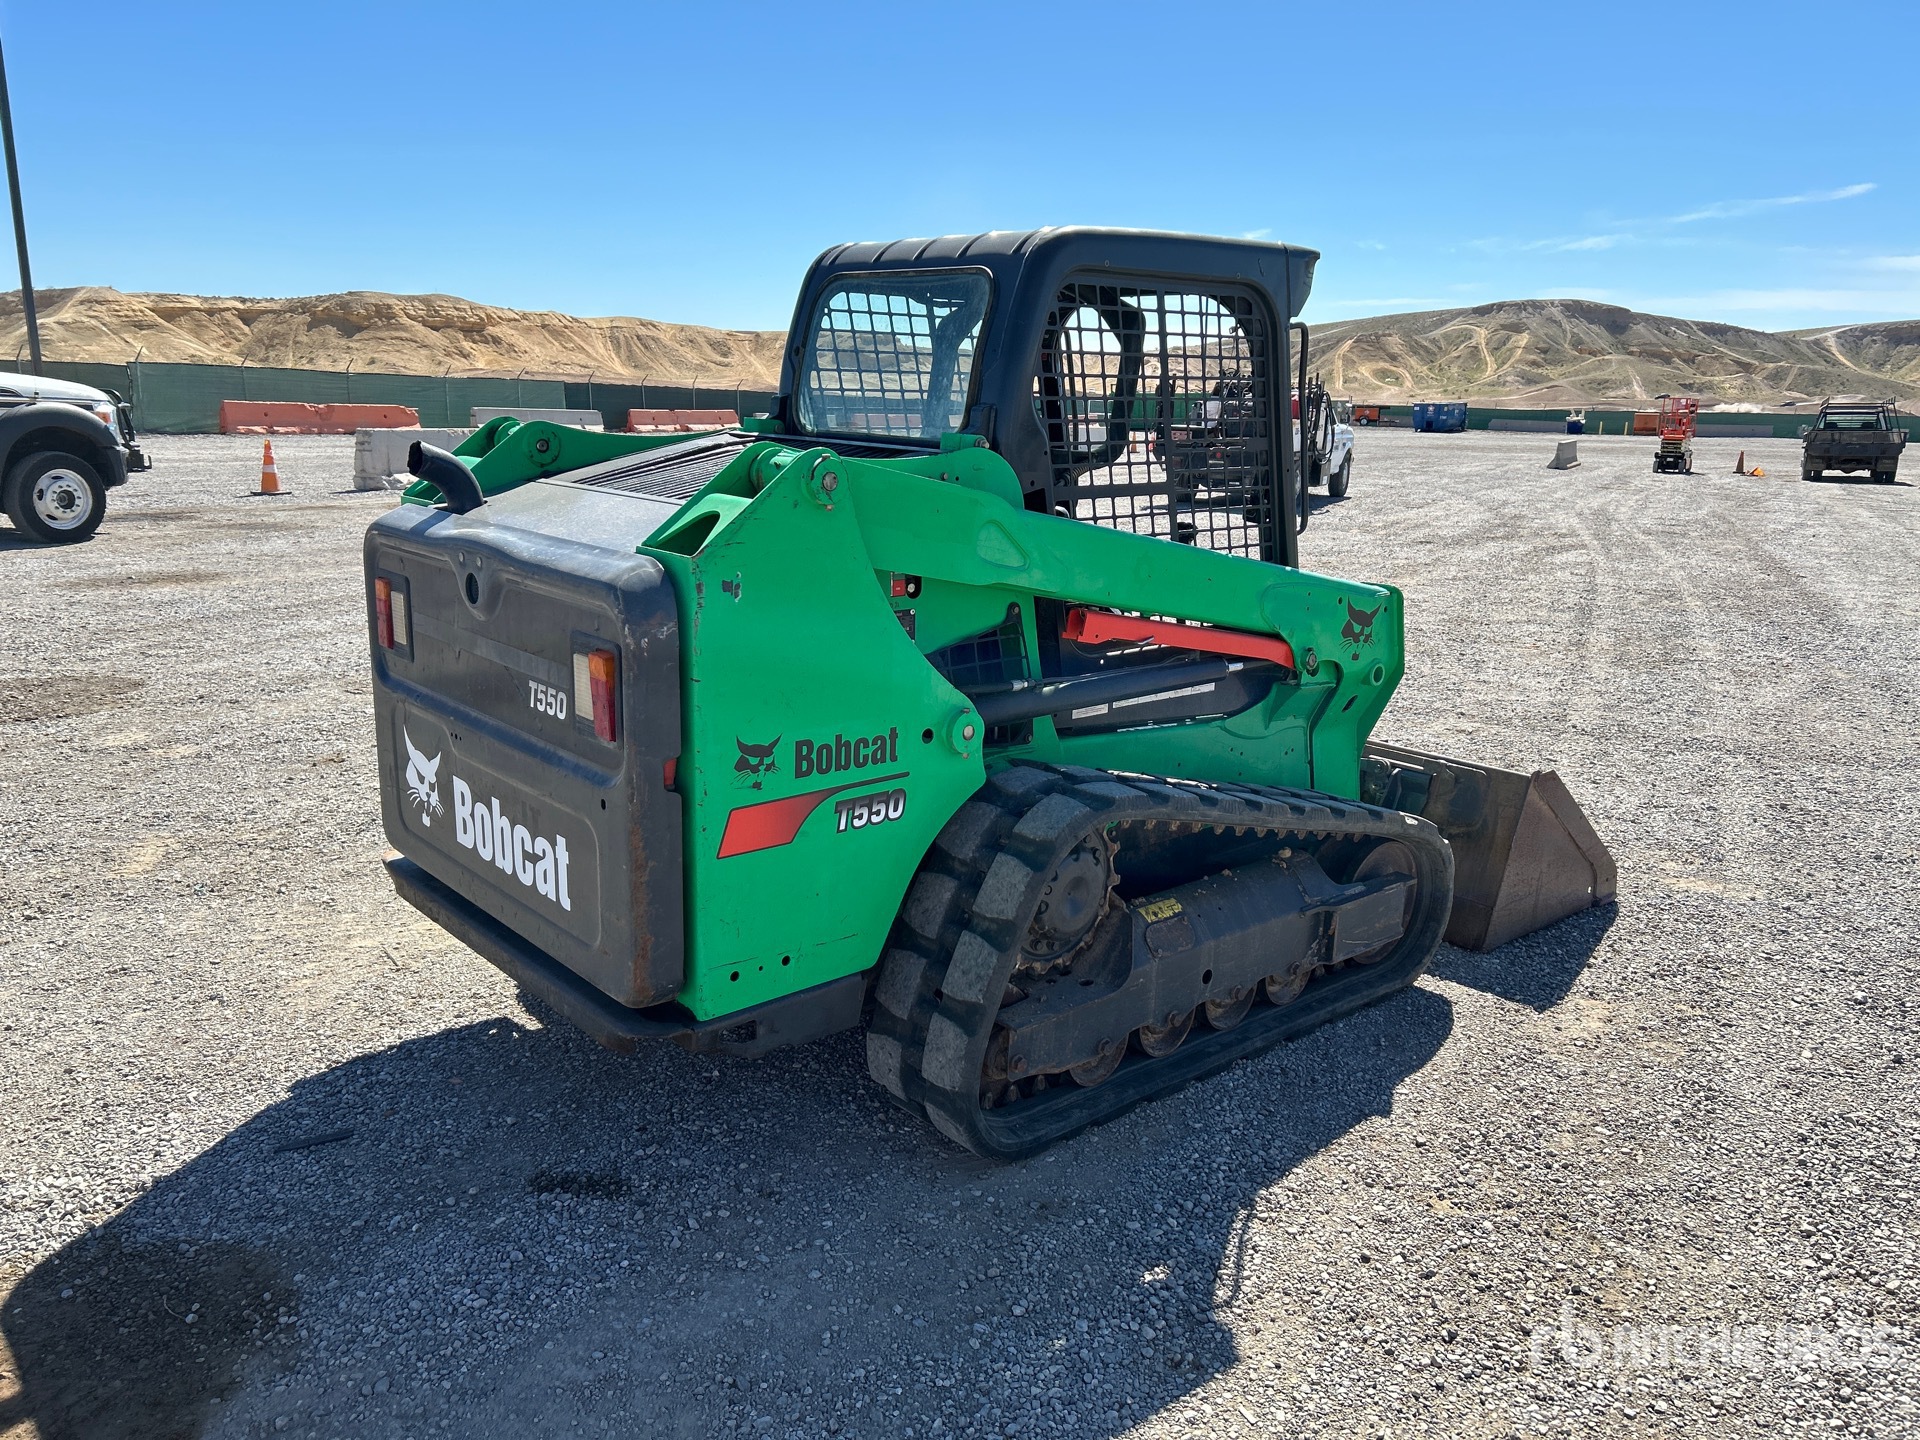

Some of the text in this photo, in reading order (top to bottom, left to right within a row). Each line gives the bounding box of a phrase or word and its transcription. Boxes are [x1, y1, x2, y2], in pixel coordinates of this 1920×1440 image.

[528, 679, 567, 720] T550
[795, 727, 898, 778] Bobcat
[834, 788, 907, 834] T550
[453, 775, 571, 912] Bobcat
